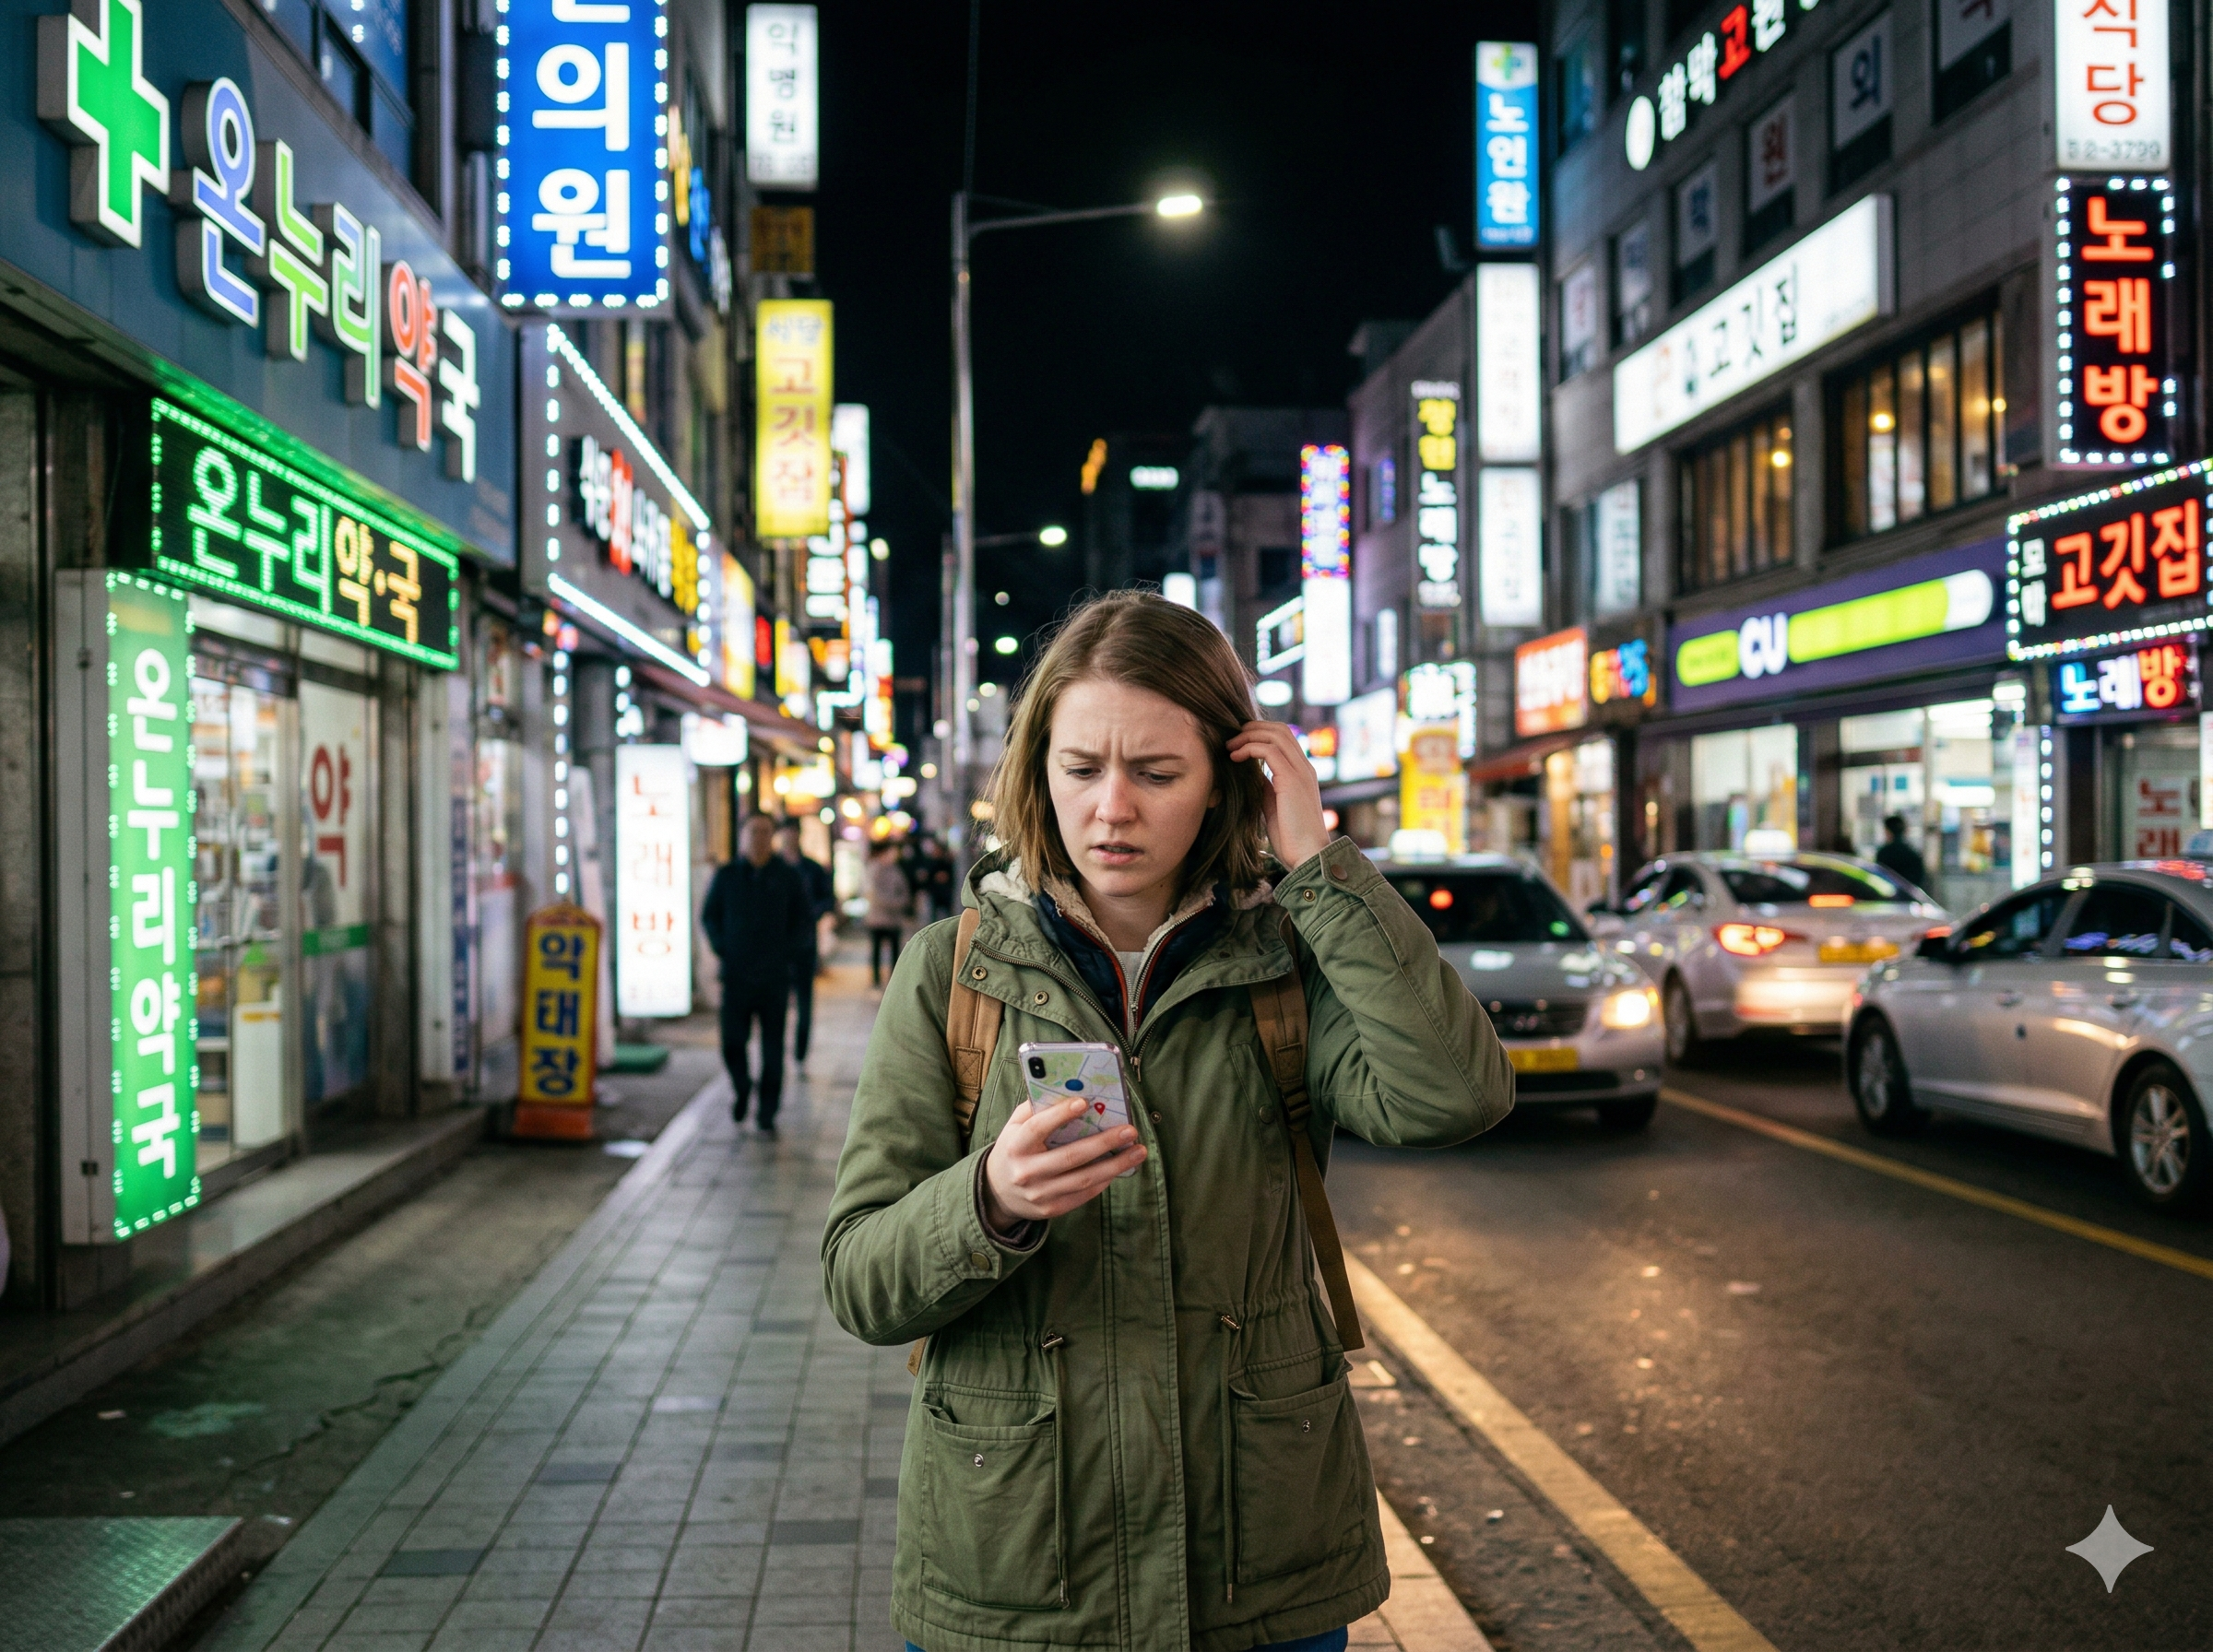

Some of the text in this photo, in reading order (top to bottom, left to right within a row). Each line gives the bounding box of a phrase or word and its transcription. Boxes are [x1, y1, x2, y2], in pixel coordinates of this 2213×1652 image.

[2082, 0, 2145, 125] 식당
[193, 77, 480, 483] 온누리약국
[2081, 196, 2159, 443] 노래방
[2051, 498, 2201, 611] 고깃집
[1739, 611, 1787, 679] CU
[311, 743, 351, 891] 약
[631, 773, 677, 957] 노래방
[126, 647, 181, 1179] 온누리약국
